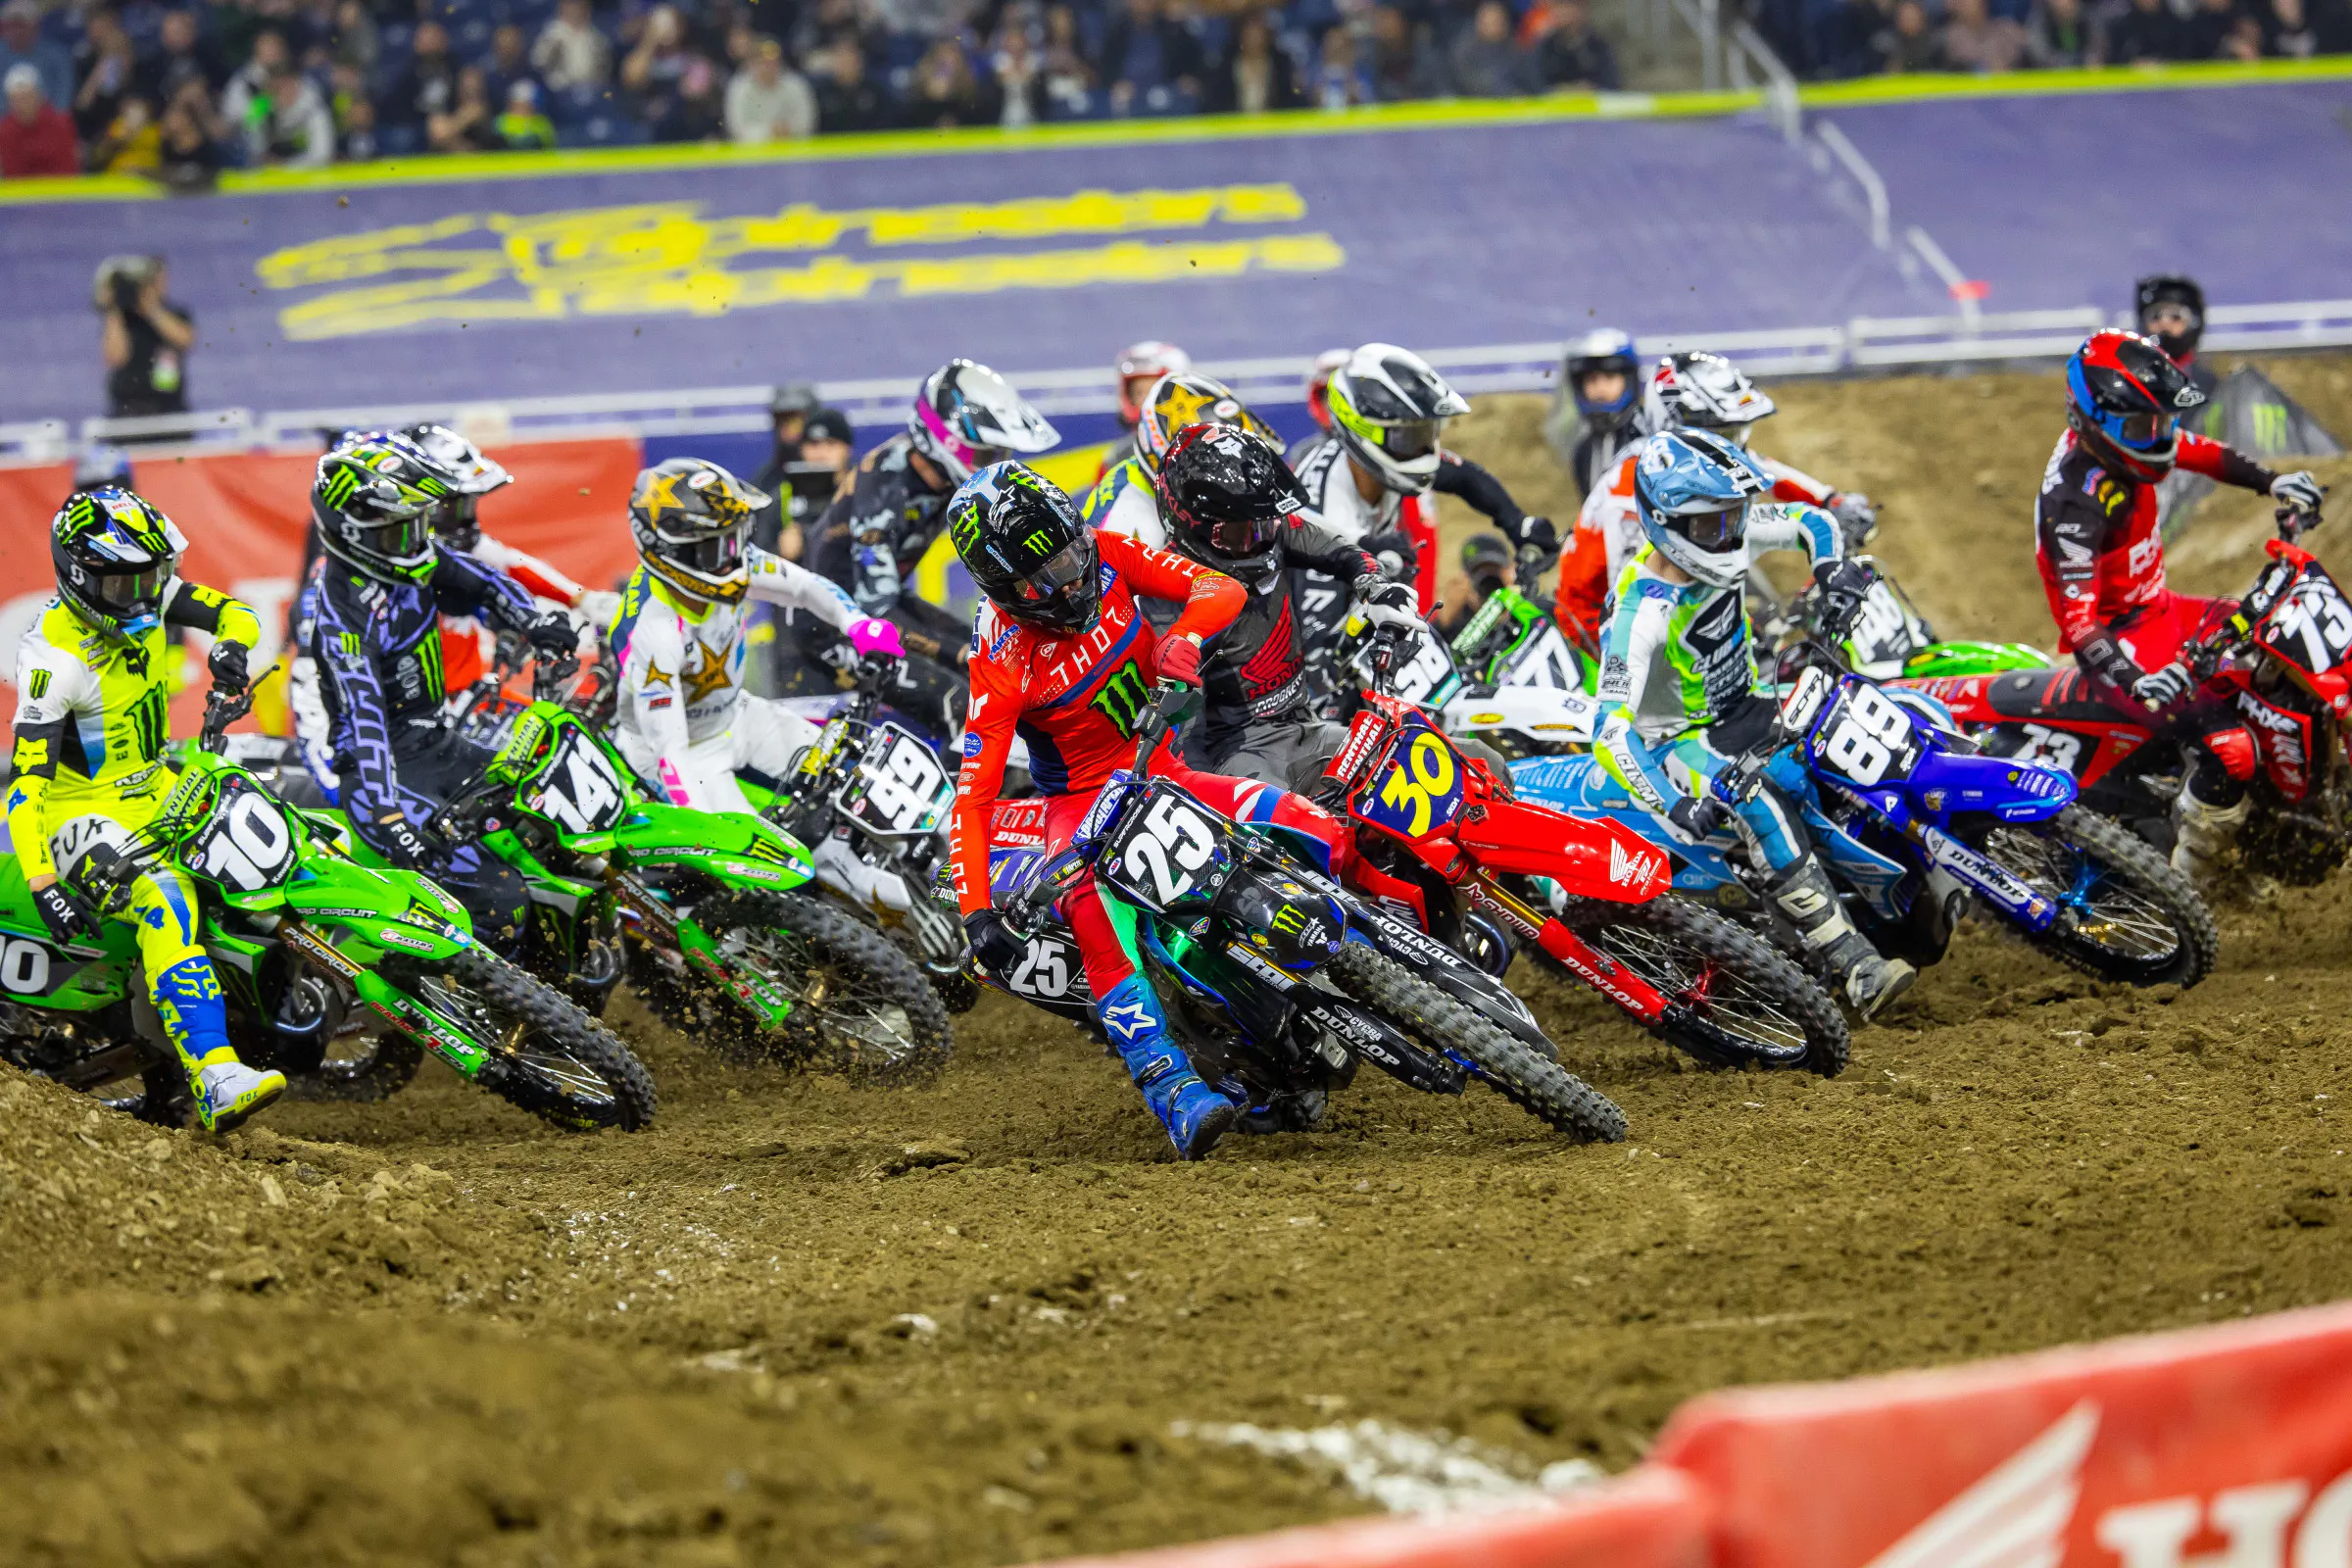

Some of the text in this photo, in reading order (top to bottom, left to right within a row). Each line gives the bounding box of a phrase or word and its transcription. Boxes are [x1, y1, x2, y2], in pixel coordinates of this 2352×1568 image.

[111, 502, 133, 511] BELL
[1159, 471, 1201, 530] OAKLEY
[985, 544, 1013, 573] apdesigns
[1122, 536, 1199, 579] THOR
[988, 623, 1020, 662] PARTS
[1051, 605, 1126, 686] THOR
[2282, 591, 2352, 675] 73
[1249, 655, 1301, 701] HOND
[1789, 674, 1821, 726] SCAR
[1337, 713, 1374, 777] RENTHAL
[1347, 721, 1383, 781] RENTHAL
[1826, 683, 1912, 787] 89
[2014, 722, 2082, 770] 73
[542, 732, 621, 835] 141
[1380, 732, 1454, 838] 30
[205, 792, 290, 892] 10
[390, 823, 425, 858] FOX
[993, 830, 1045, 845] DUNL
[1113, 804, 1145, 849] SUPERCROSS
[1124, 794, 1215, 906] 25
[271, 849, 296, 884] Kawasaki
[653, 846, 718, 858] CIRCUIT
[949, 813, 968, 897] THOR
[1620, 850, 1645, 888] HONDA
[1948, 849, 2026, 899] DUNLOP
[43, 888, 76, 923] FOX
[319, 907, 378, 918] CIRCUIT
[637, 892, 679, 926] CIRCUI
[1481, 895, 1541, 941] SHOWA
[284, 926, 315, 949] PRO
[394, 935, 434, 951] MAXIMA
[1371, 914, 1462, 968] DUNLOP
[0, 935, 49, 994] 0
[1009, 938, 1068, 999] 25
[1226, 943, 1298, 993] star
[1561, 955, 1645, 1013] DUNLOP
[369, 1001, 416, 1035] BRAKING
[392, 997, 477, 1056] DUNLOP
[1309, 1005, 1401, 1067] DUNLOP
[1348, 1015, 1384, 1043] CYCRA
[240, 1090, 259, 1104] FOX
